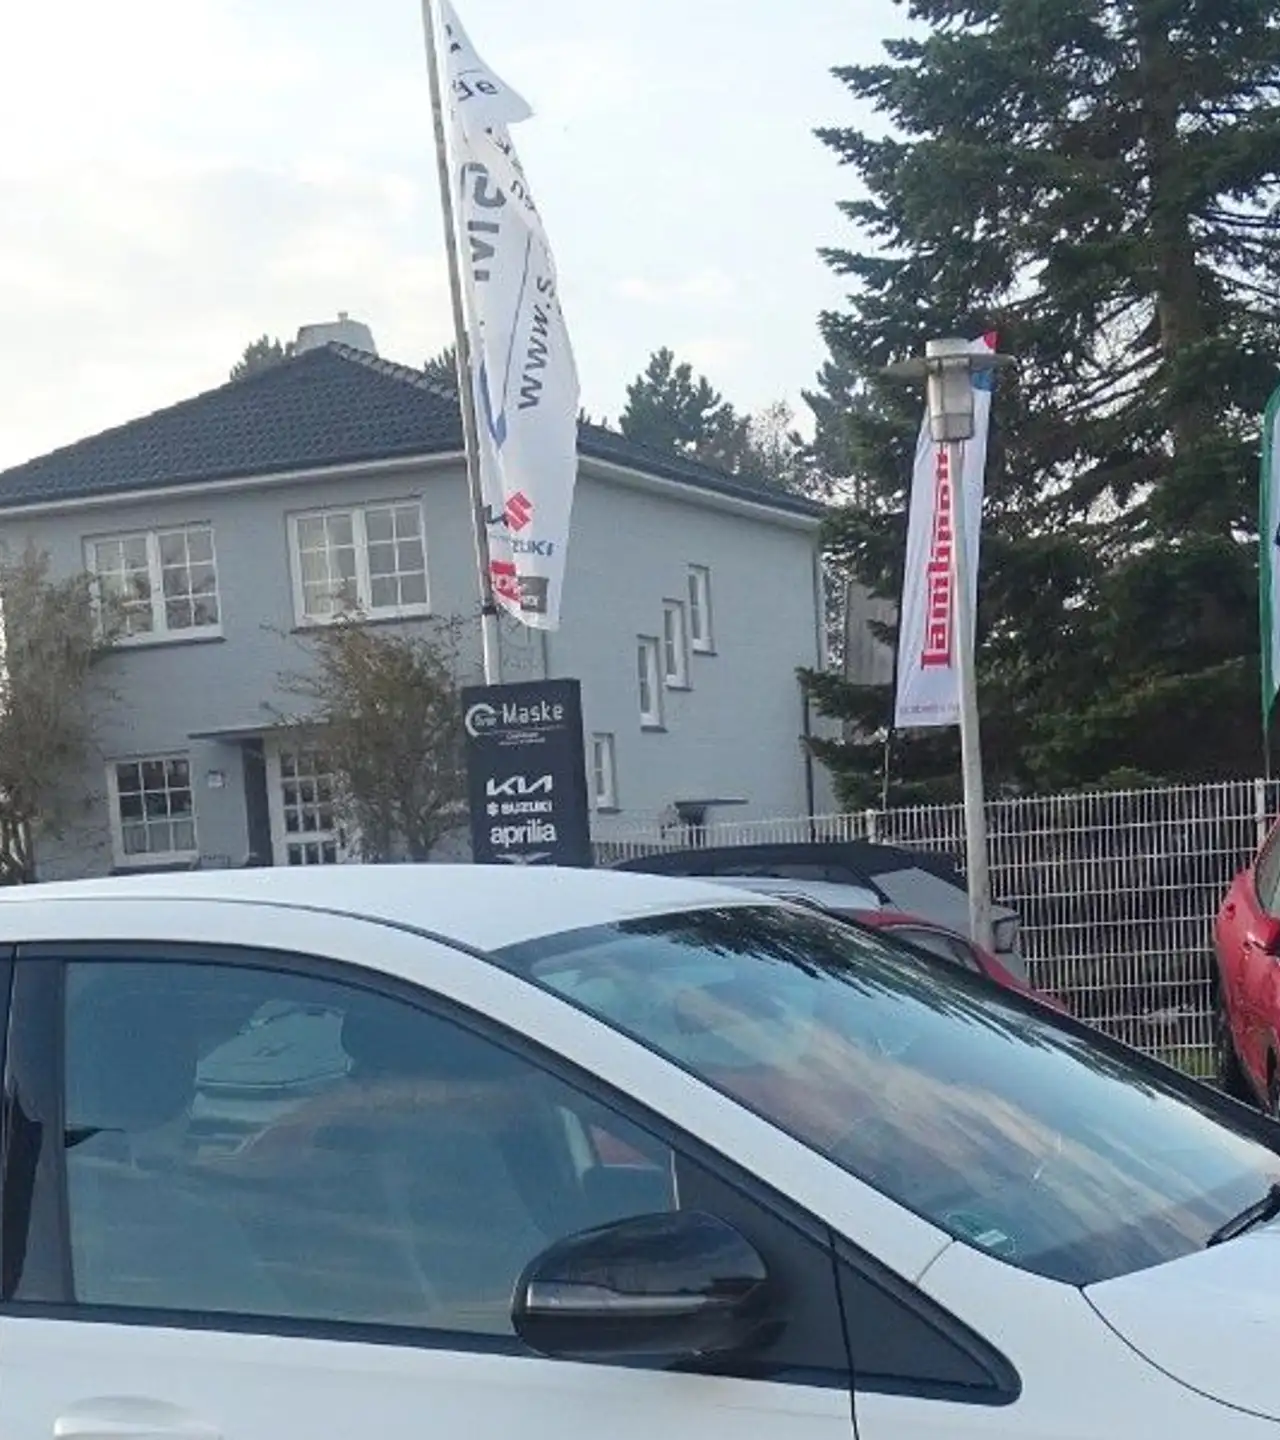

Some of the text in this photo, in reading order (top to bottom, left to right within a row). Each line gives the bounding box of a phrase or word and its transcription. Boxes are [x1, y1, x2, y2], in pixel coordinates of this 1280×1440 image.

[501, 701, 565, 725] Maske
[486, 774, 554, 797] KIA
[500, 801, 554, 816] SUZUKI
[490, 818, 558, 848] aprilia
